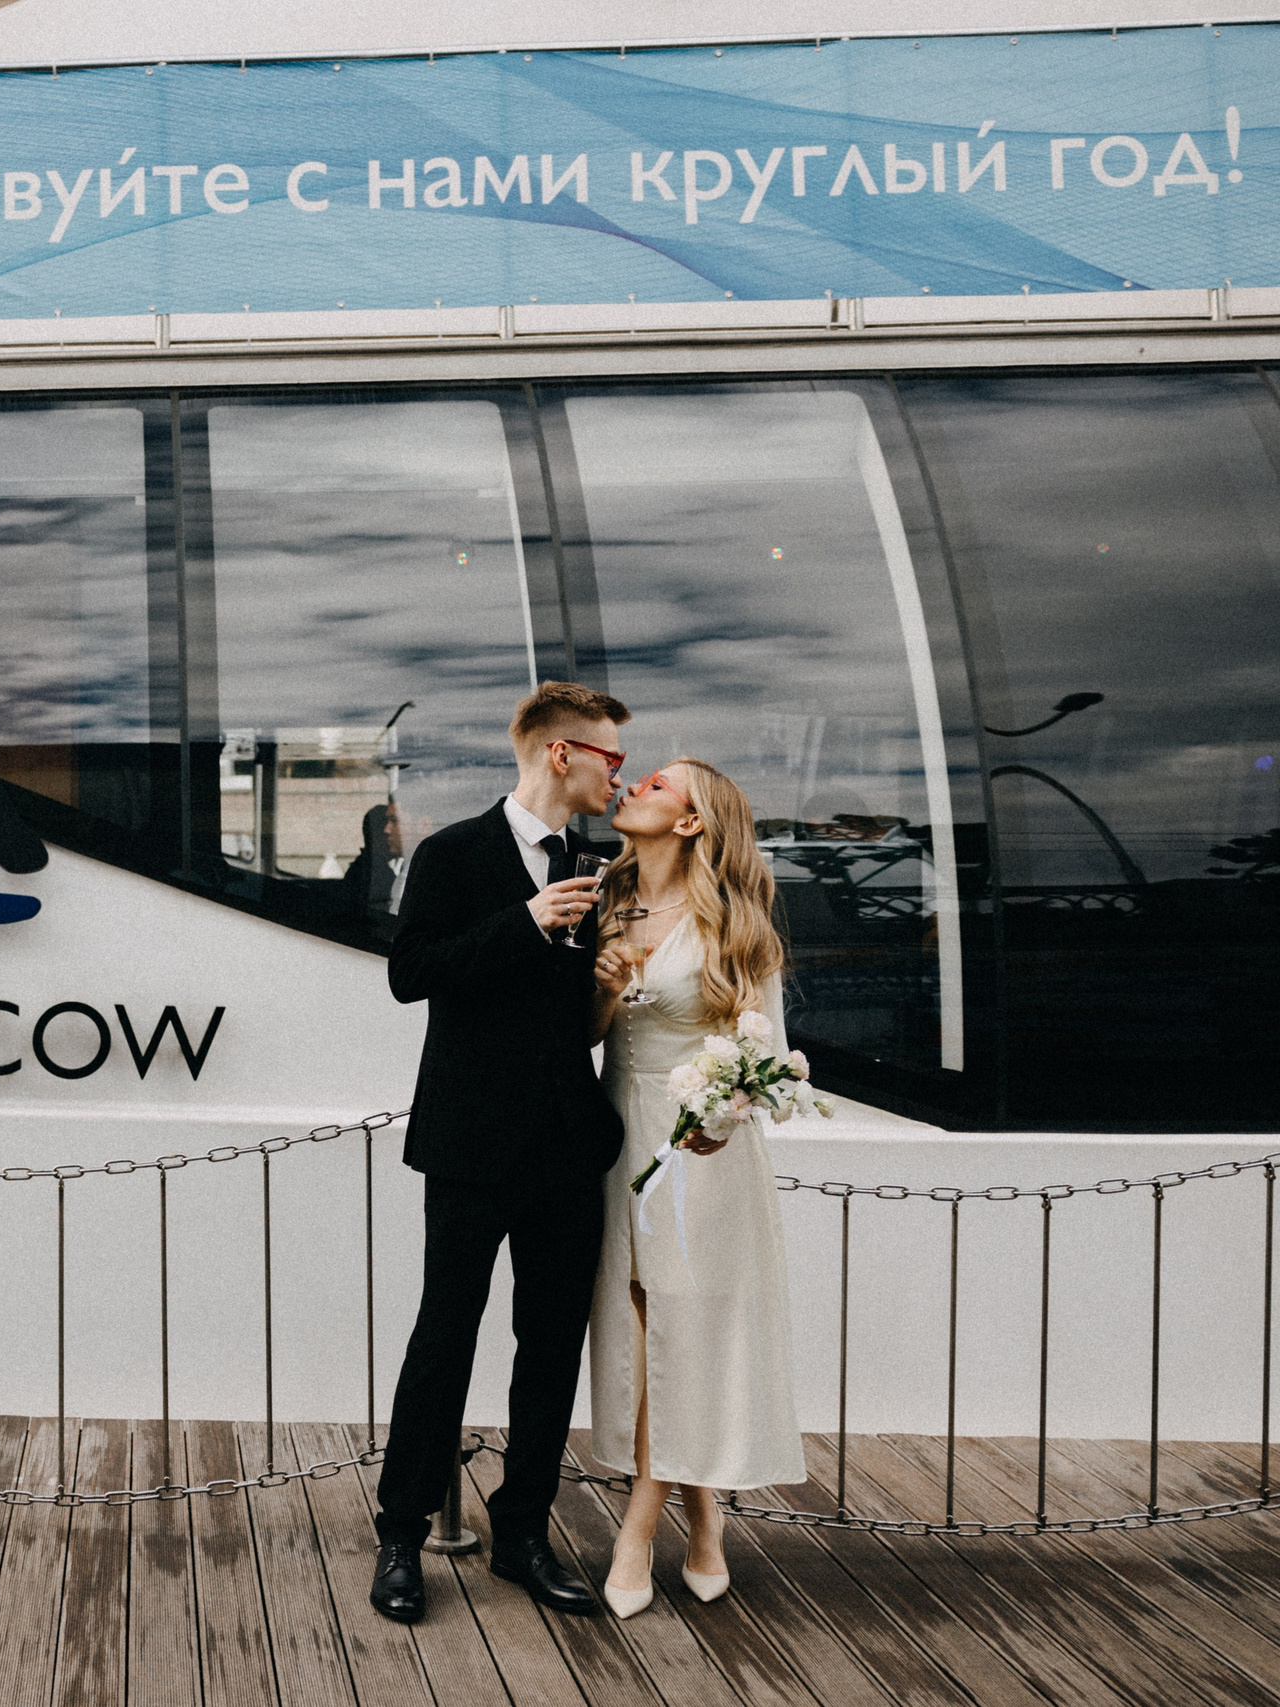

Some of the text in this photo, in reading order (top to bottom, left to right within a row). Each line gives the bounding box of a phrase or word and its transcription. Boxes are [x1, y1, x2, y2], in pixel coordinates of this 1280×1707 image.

[285, 160, 329, 214] с
[367, 152, 589, 209] нами
[629, 119, 1008, 226] круглый
[1050, 105, 1244, 197] год!
